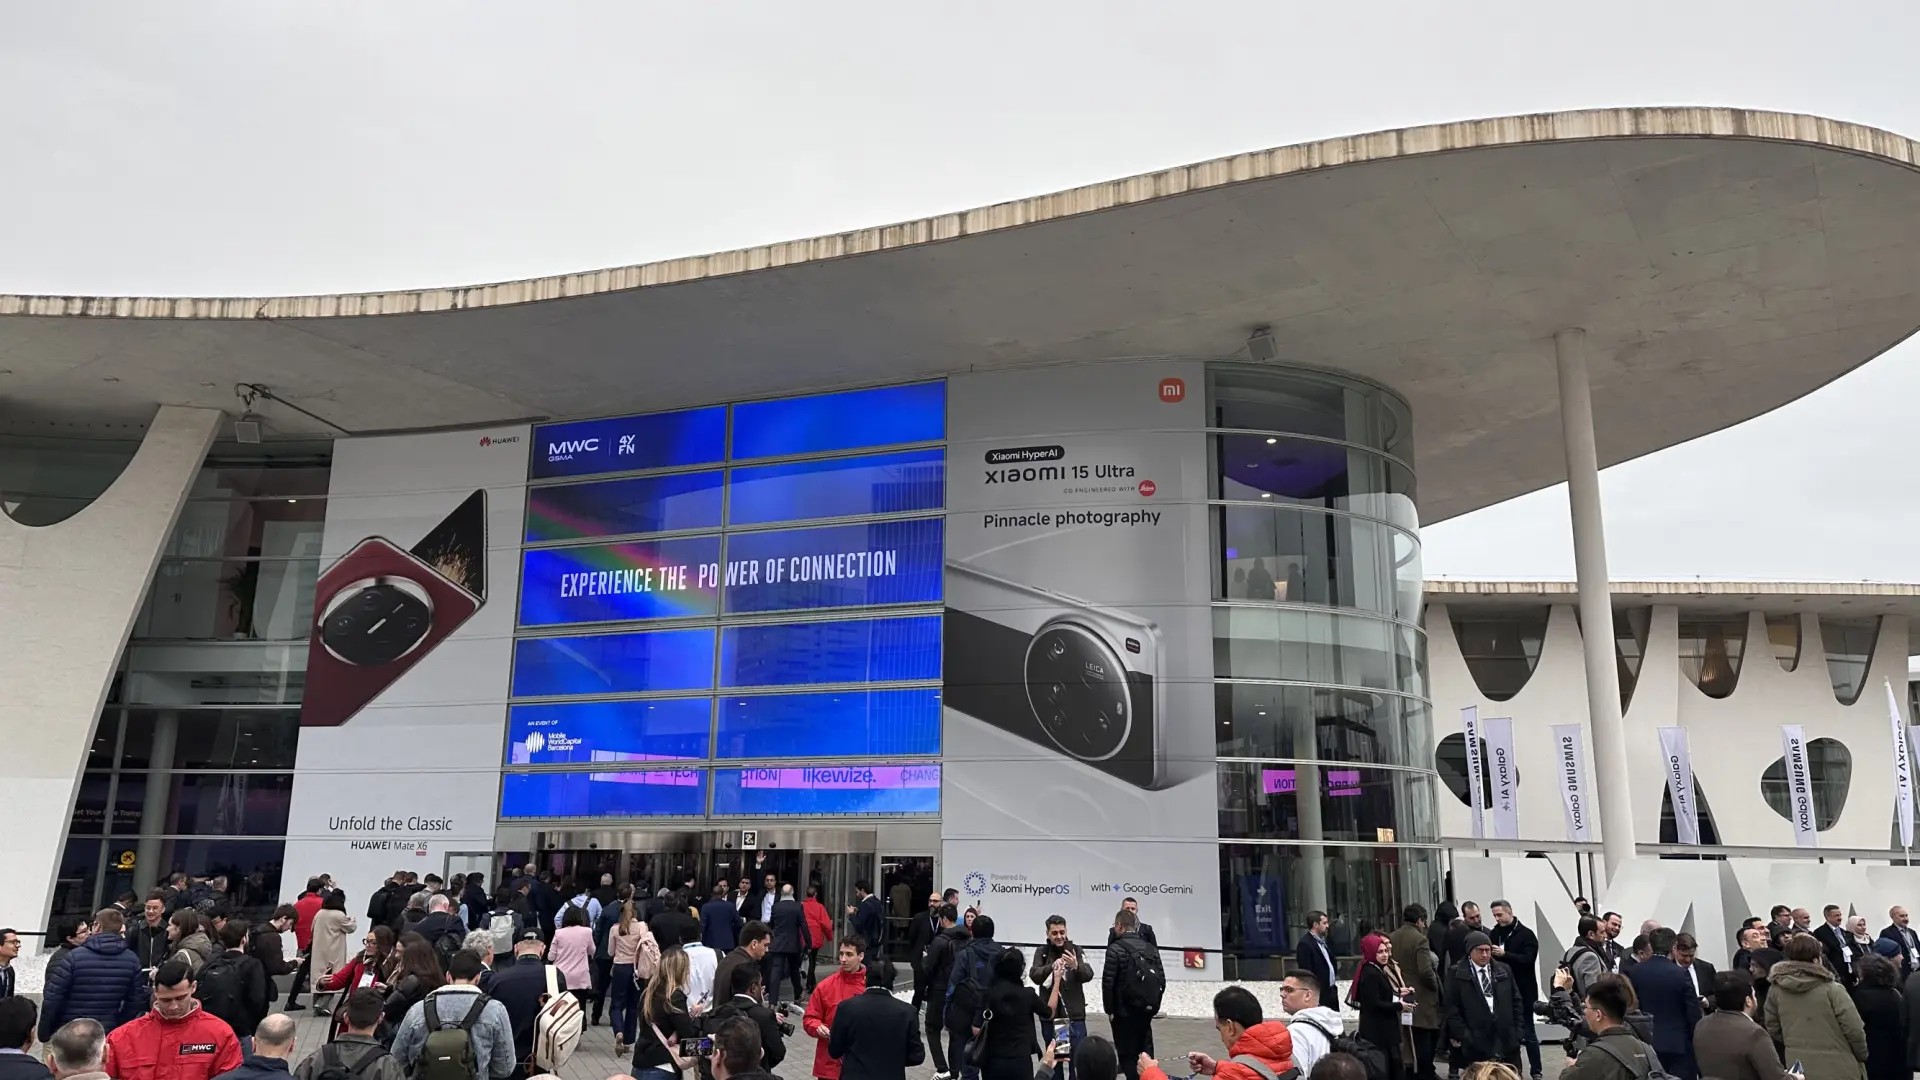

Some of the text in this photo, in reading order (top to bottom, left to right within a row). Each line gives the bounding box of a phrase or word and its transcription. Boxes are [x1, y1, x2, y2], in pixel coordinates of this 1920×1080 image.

[492, 436, 519, 444] HUAWEI
[549, 438, 599, 455] MWC
[619, 434, 636, 446] 4Y
[618, 444, 635, 455] FN
[992, 449, 1058, 461] Xiaomi HyperAI
[548, 454, 574, 462] GSMA
[1071, 465, 1089, 479] 15
[1095, 464, 1135, 478] Ultra
[984, 509, 1161, 528] Pinnacle photography
[561, 550, 896, 598] EXPERIENCE THE POWER OF CONNECTION
[1085, 661, 1104, 674] LEICA
[802, 767, 876, 783] likewize.
[329, 816, 453, 831] Unfold the Classic
[350, 841, 428, 851] HUAWEI Mate X6
[990, 873, 1028, 883] Powered by
[990, 883, 1070, 897] Xiaomi HyperOS
[1091, 882, 1194, 896] with Google Gemini
